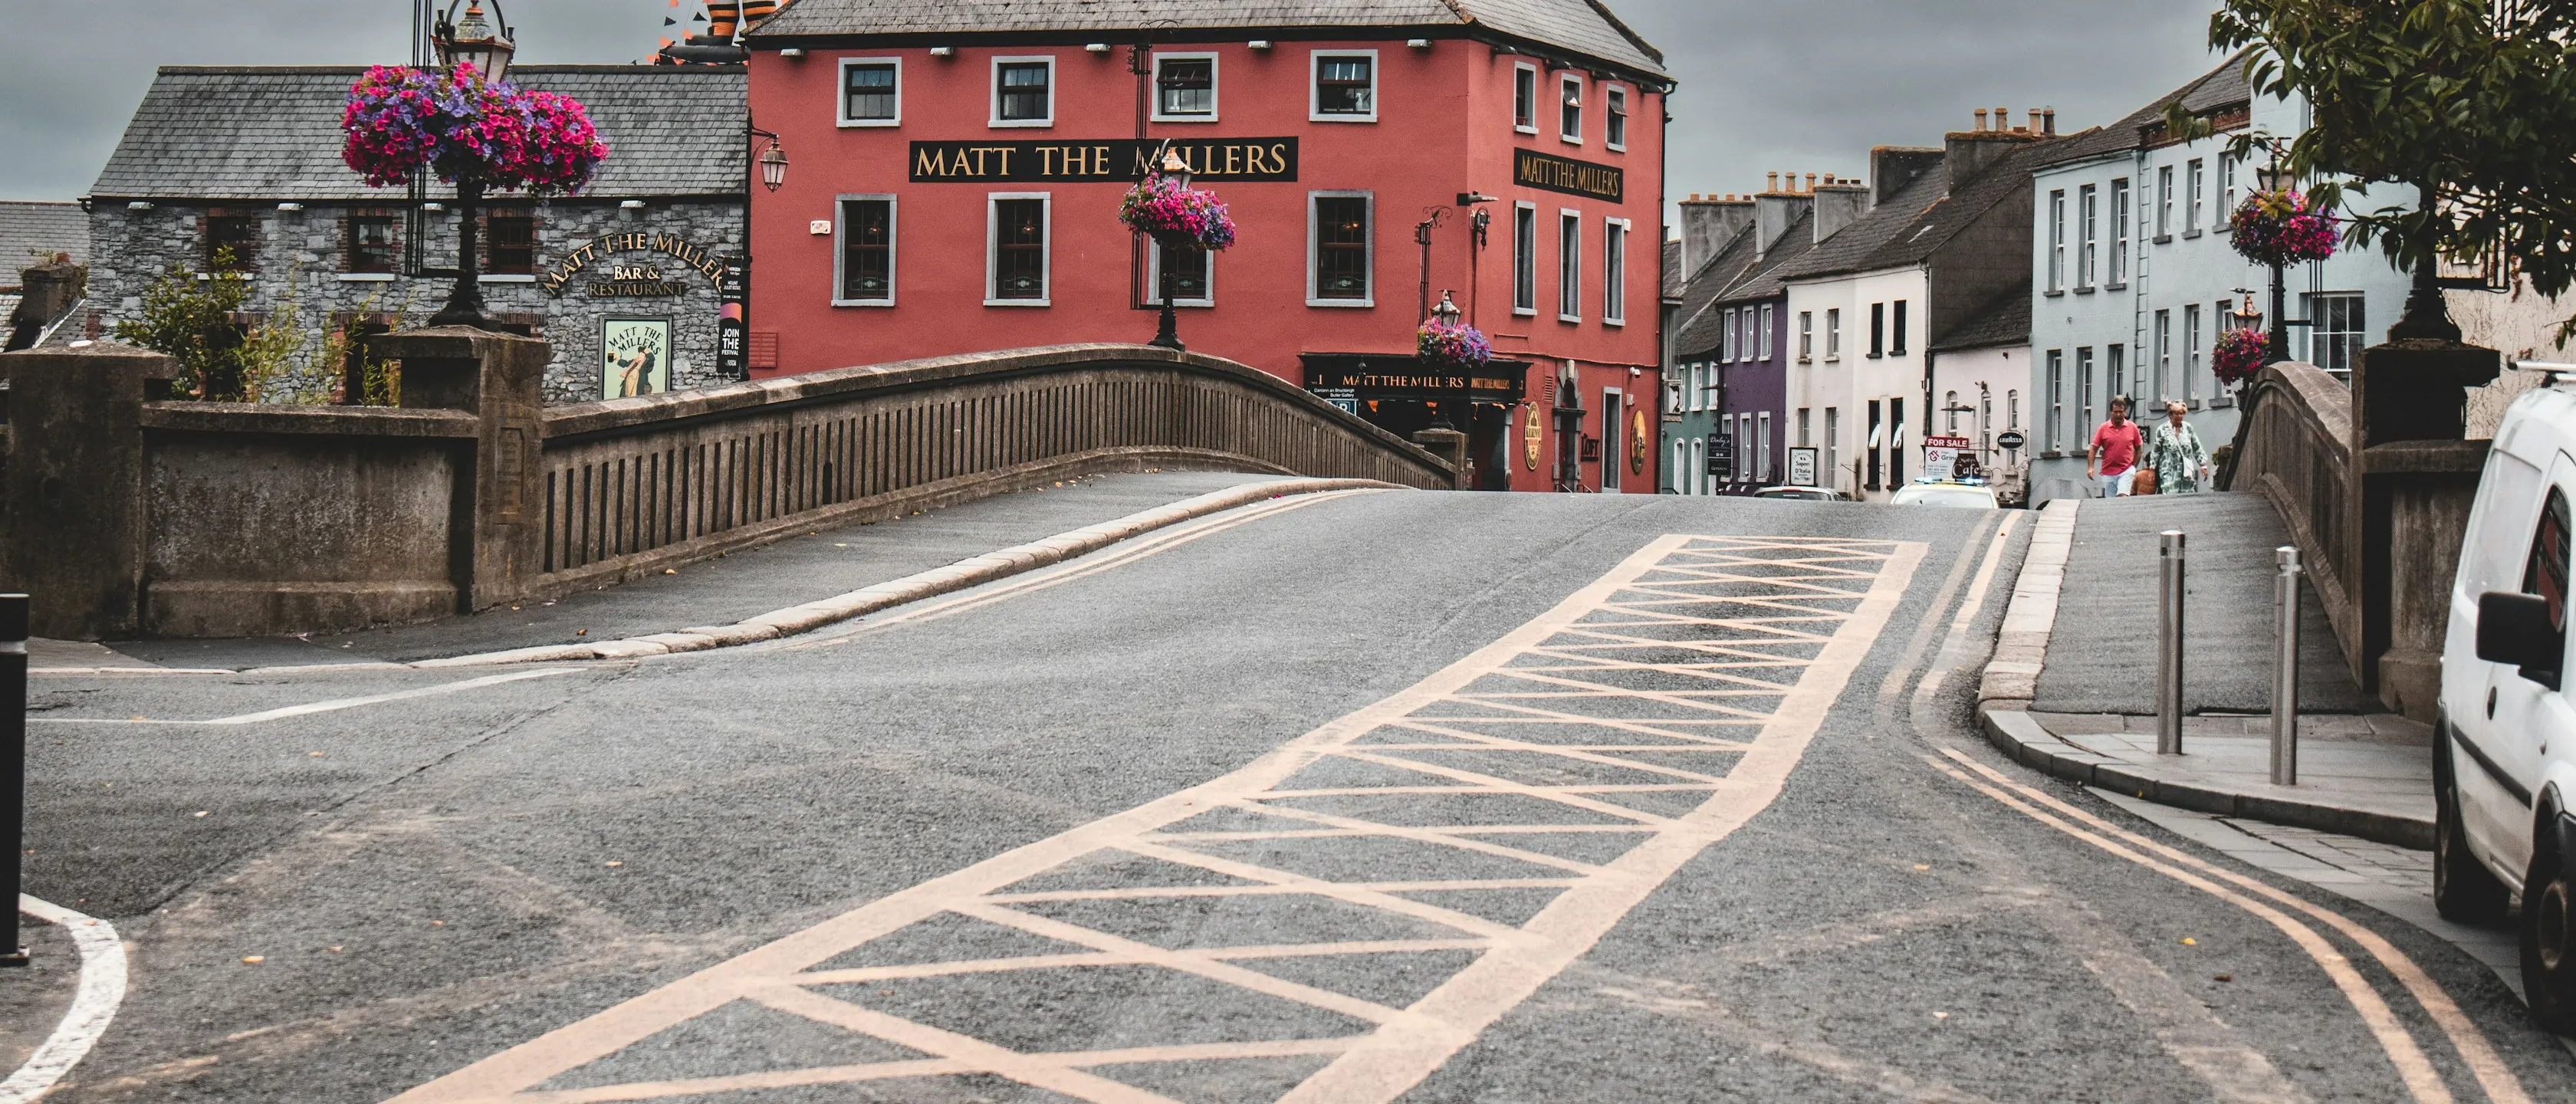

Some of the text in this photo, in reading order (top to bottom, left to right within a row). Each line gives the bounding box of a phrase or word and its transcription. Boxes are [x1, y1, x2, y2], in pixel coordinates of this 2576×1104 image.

[915, 147, 1016, 176] MATT
[1035, 146, 1109, 176] THE
[1520, 155, 1618, 196] MATT THE MILLERS
[543, 243, 595, 296] MATT
[600, 233, 646, 255] THE
[646, 267, 660, 279] &
[609, 326, 663, 348] MATT THE
[723, 328, 739, 337] JOIN
[618, 337, 662, 357] MILLERS
[722, 338, 739, 350] THE
[1381, 376, 1408, 386] THE
[1411, 376, 1464, 387] MILLRS
[1710, 436, 1730, 448] Daly's
[1947, 439, 1967, 448] SALE
[1952, 463, 1980, 477] Cafe
